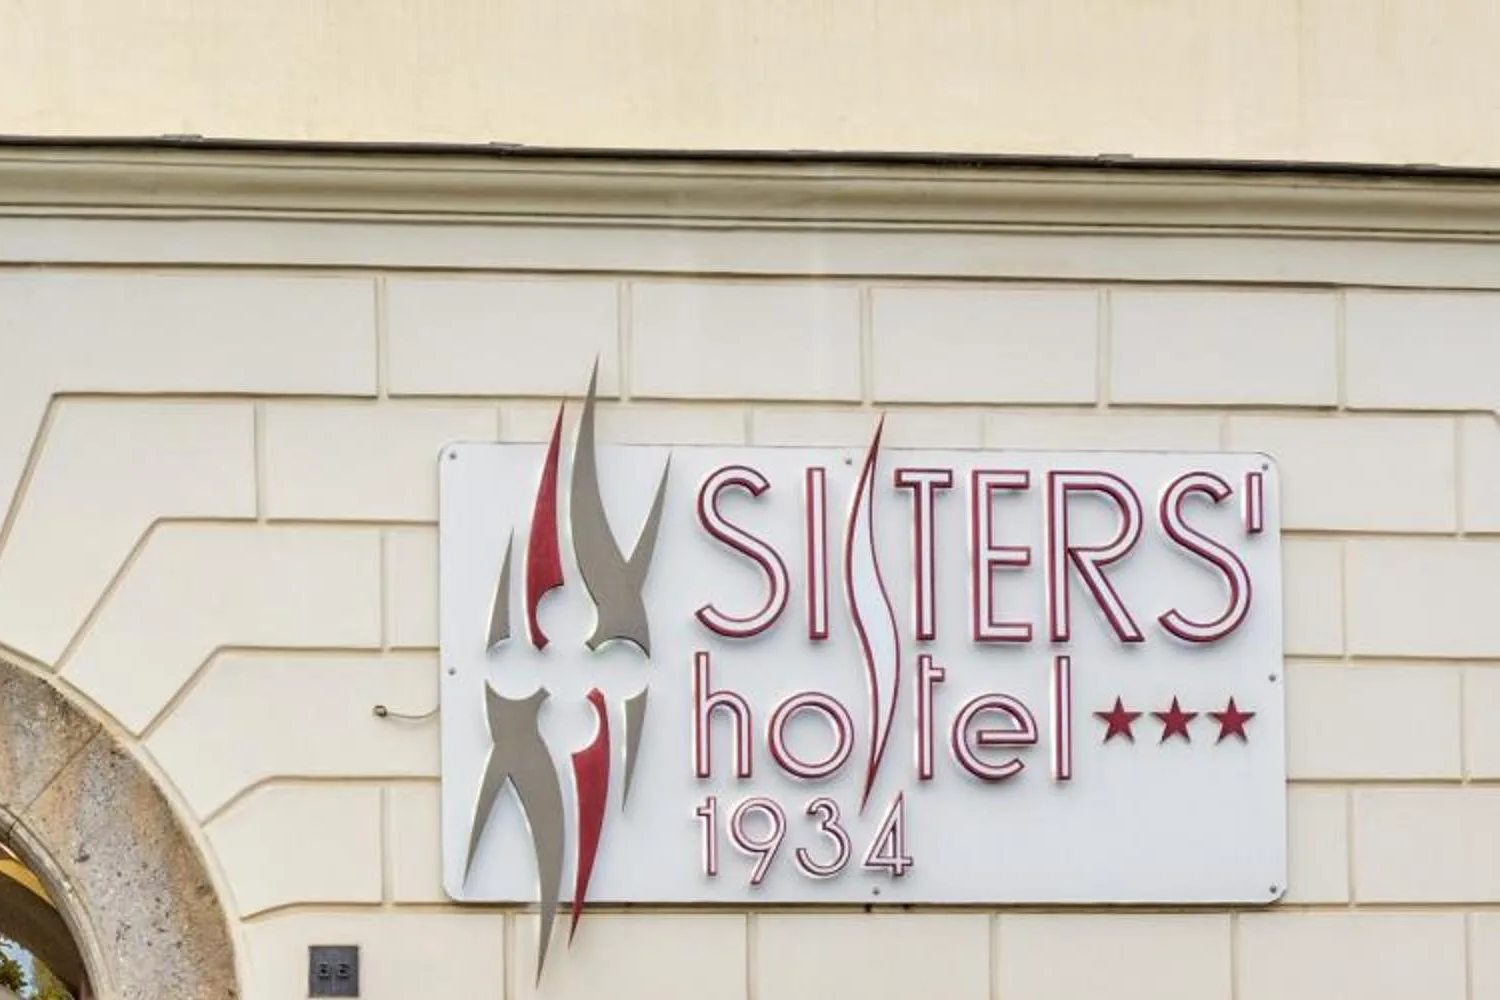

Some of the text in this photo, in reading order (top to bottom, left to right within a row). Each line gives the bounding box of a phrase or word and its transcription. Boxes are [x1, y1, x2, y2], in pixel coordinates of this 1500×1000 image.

[695, 463, 1264, 644] SISTERS'
[691, 650, 1074, 784] hotel
[695, 790, 915, 886] 1934
